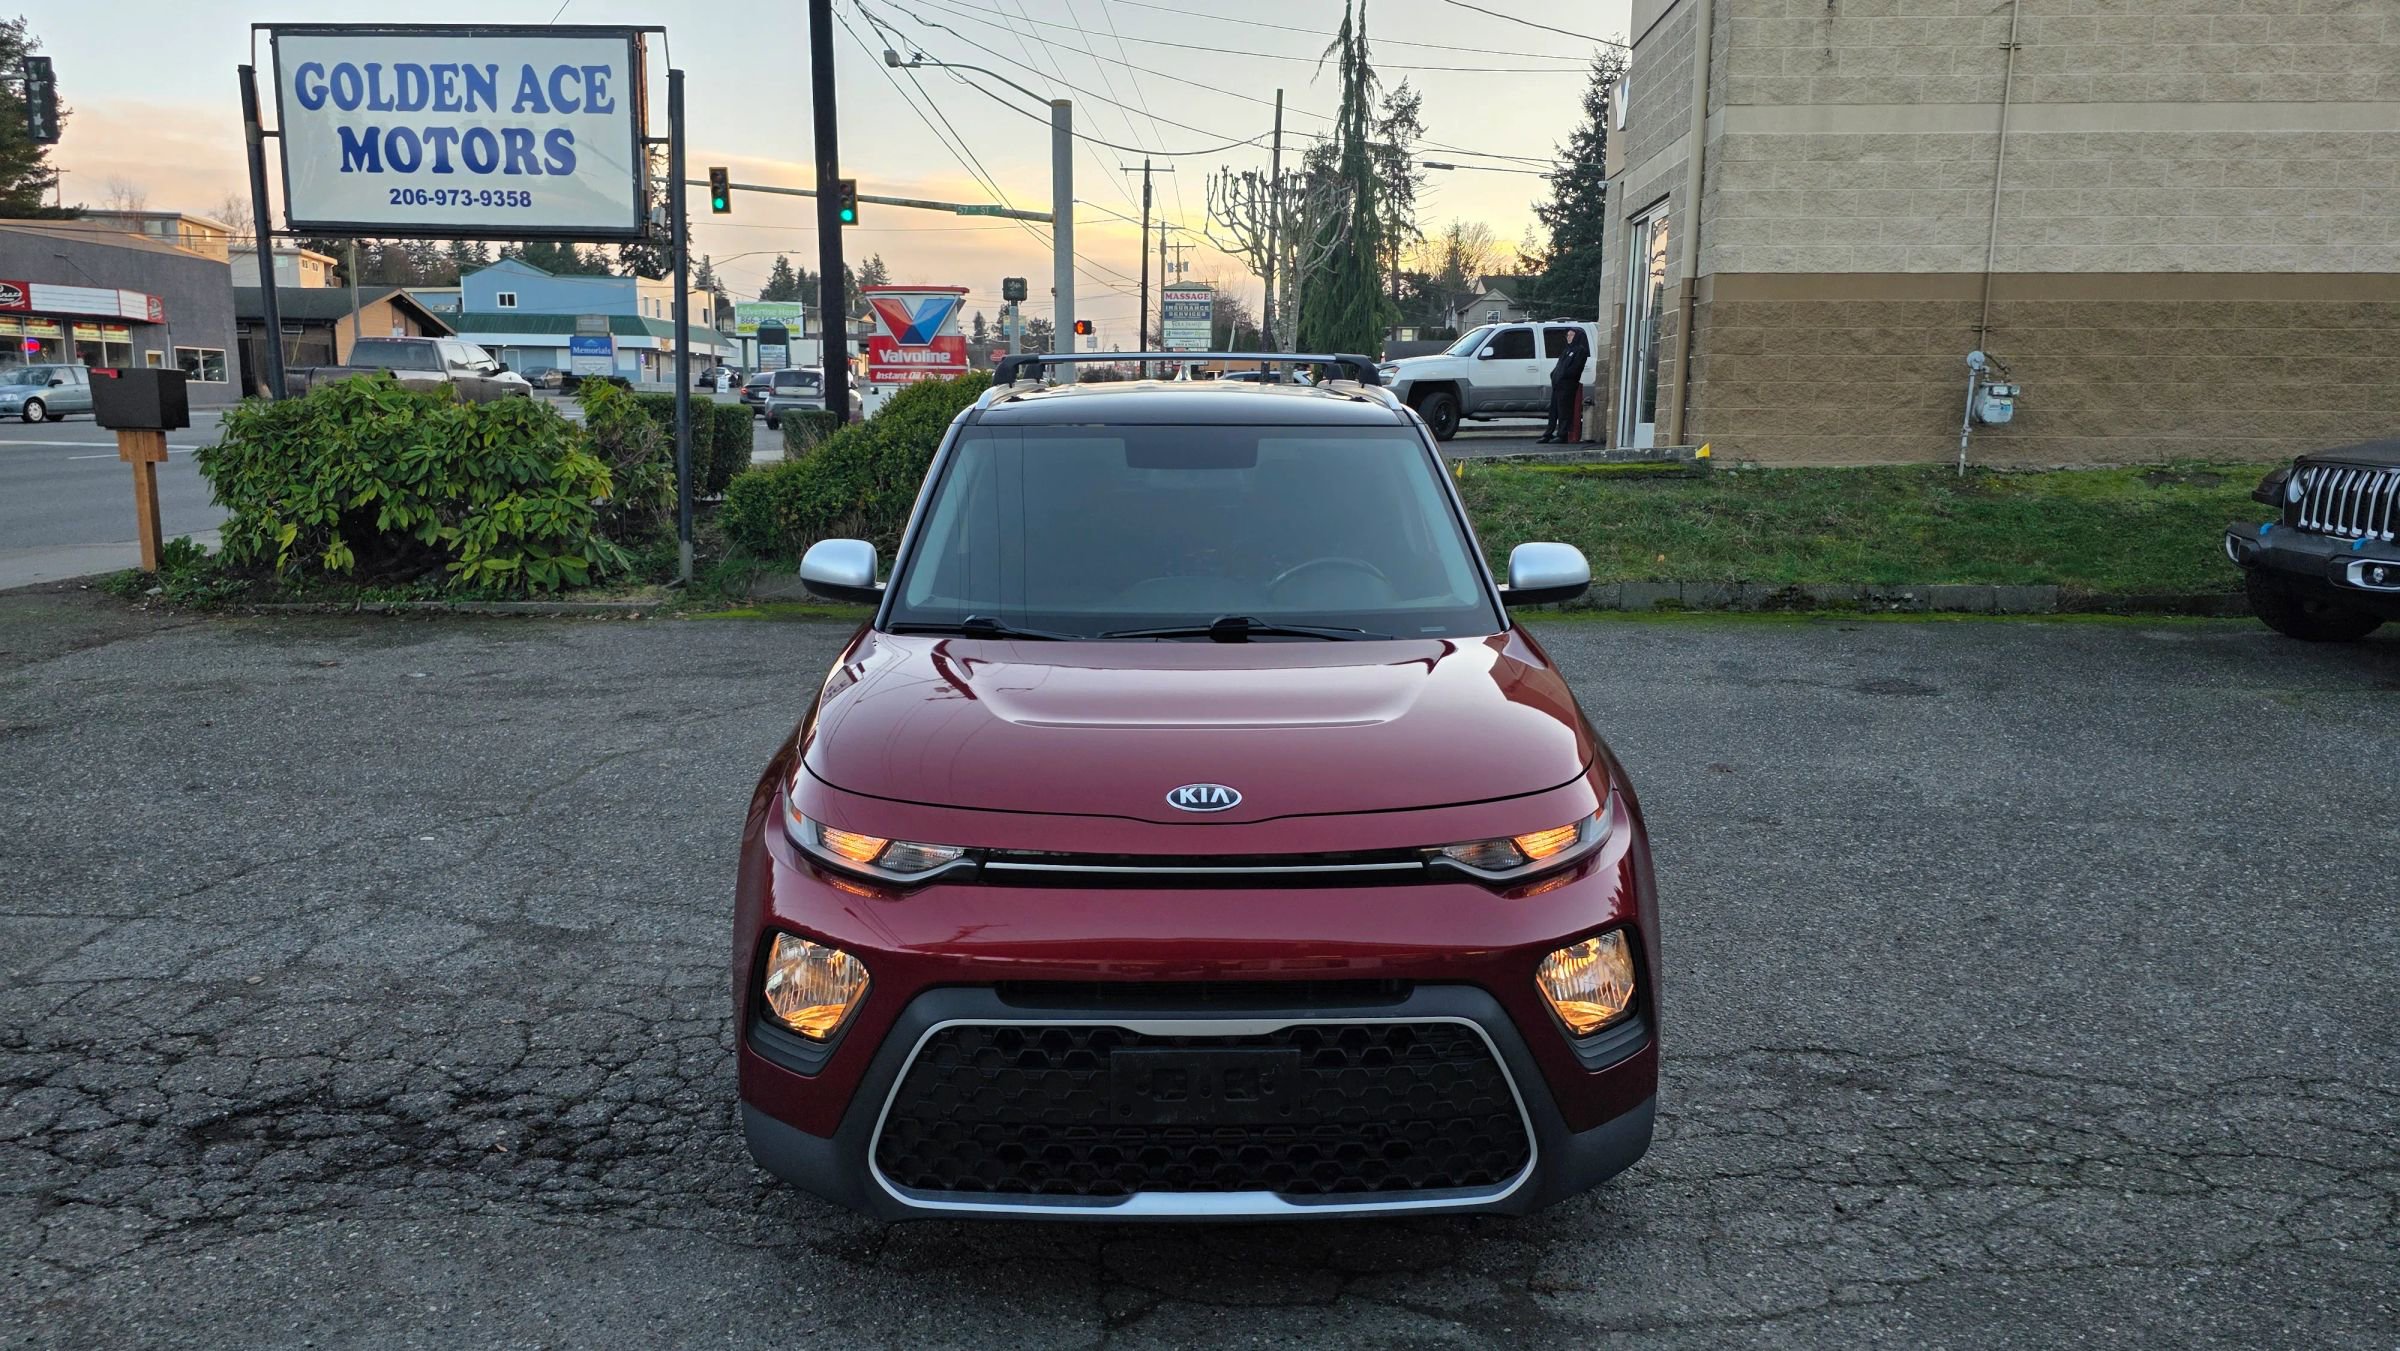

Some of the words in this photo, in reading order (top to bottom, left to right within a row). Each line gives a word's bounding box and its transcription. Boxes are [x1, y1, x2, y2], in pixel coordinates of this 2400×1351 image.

[295, 61, 499, 113] GOLDEN
[511, 63, 616, 115] ACE
[337, 125, 577, 176] MOTORS
[389, 187, 533, 208] 206-973-9358
[979, 206, 990, 215] ST
[878, 349, 952, 363] Valvoline
[876, 371, 907, 380] Instant
[1179, 787, 1231, 804] KIA
